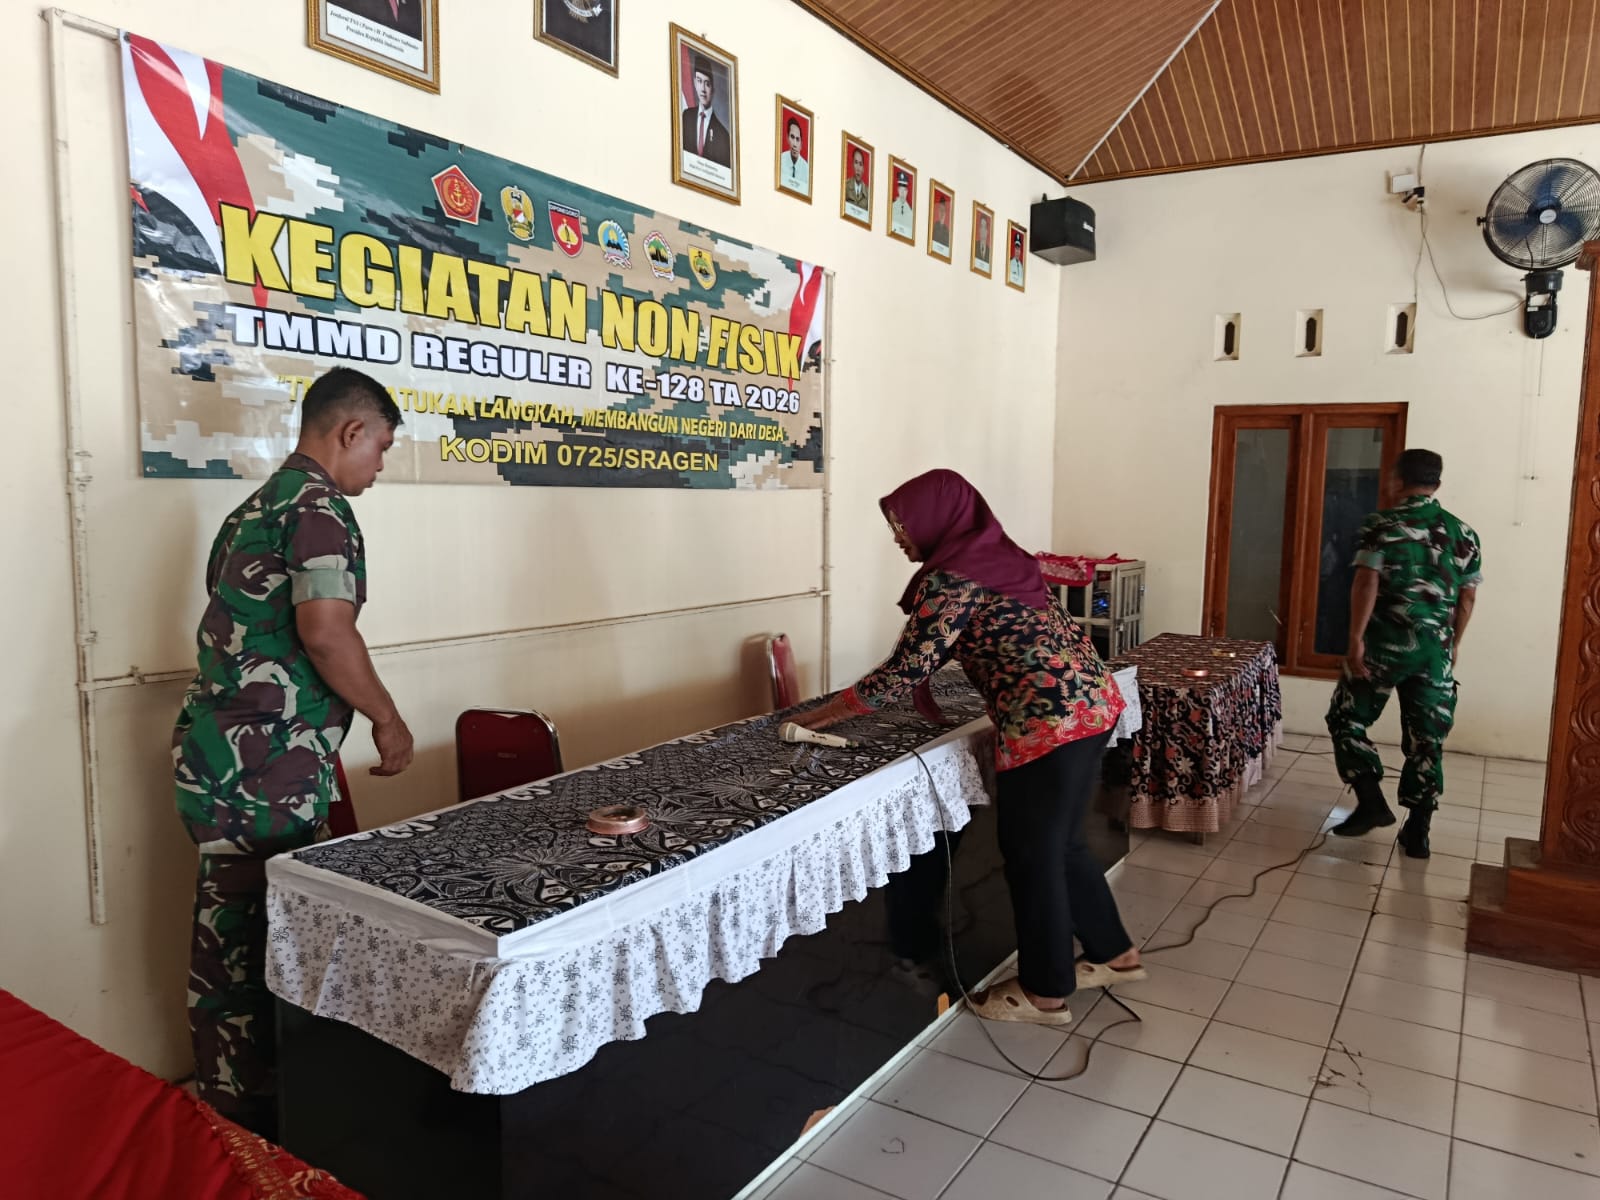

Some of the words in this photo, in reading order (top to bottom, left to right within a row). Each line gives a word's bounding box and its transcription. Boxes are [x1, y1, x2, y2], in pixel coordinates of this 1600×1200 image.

[219, 202, 587, 344] KEGIATAN
[601, 288, 701, 363] NON
[706, 314, 802, 381] FISIK
[224, 302, 401, 365] TMMD
[412, 331, 592, 389] REGULER
[709, 378, 742, 407] TA
[745, 384, 800, 415] 2026
[440, 435, 548, 465] KODIM
[556, 444, 719, 472] 0725/SRAGEN
[479, 395, 577, 428] LANGKAH,
[581, 407, 679, 434] MEMBANGUN
[681, 417, 727, 437] NEGERI
[730, 420, 757, 440] DARI
[758, 424, 784, 442] DESA
